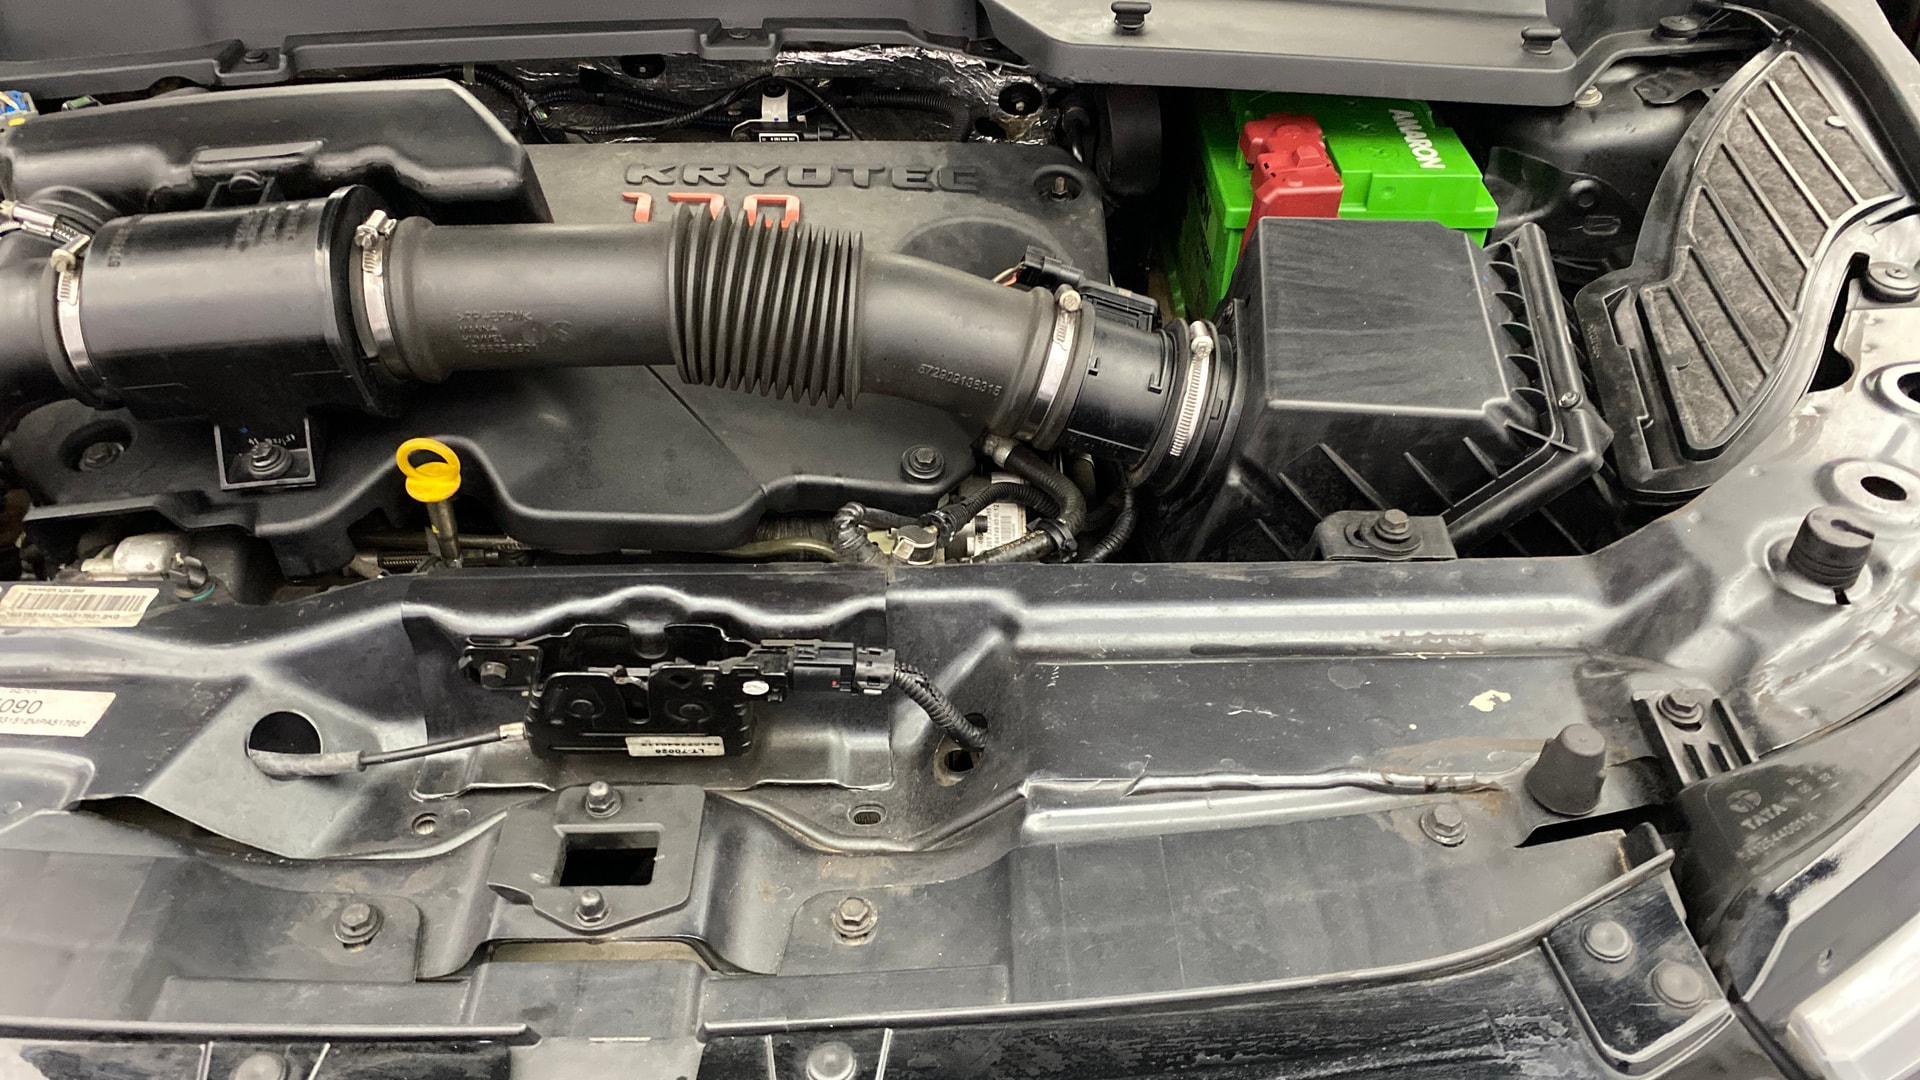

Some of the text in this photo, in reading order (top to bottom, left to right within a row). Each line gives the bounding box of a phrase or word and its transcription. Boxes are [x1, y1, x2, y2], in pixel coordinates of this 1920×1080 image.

[1388, 108, 1447, 169] AMARON
[624, 164, 981, 193] KRYOTEC
[0, 698, 43, 715] 090
[1740, 803, 1789, 831] TATA
